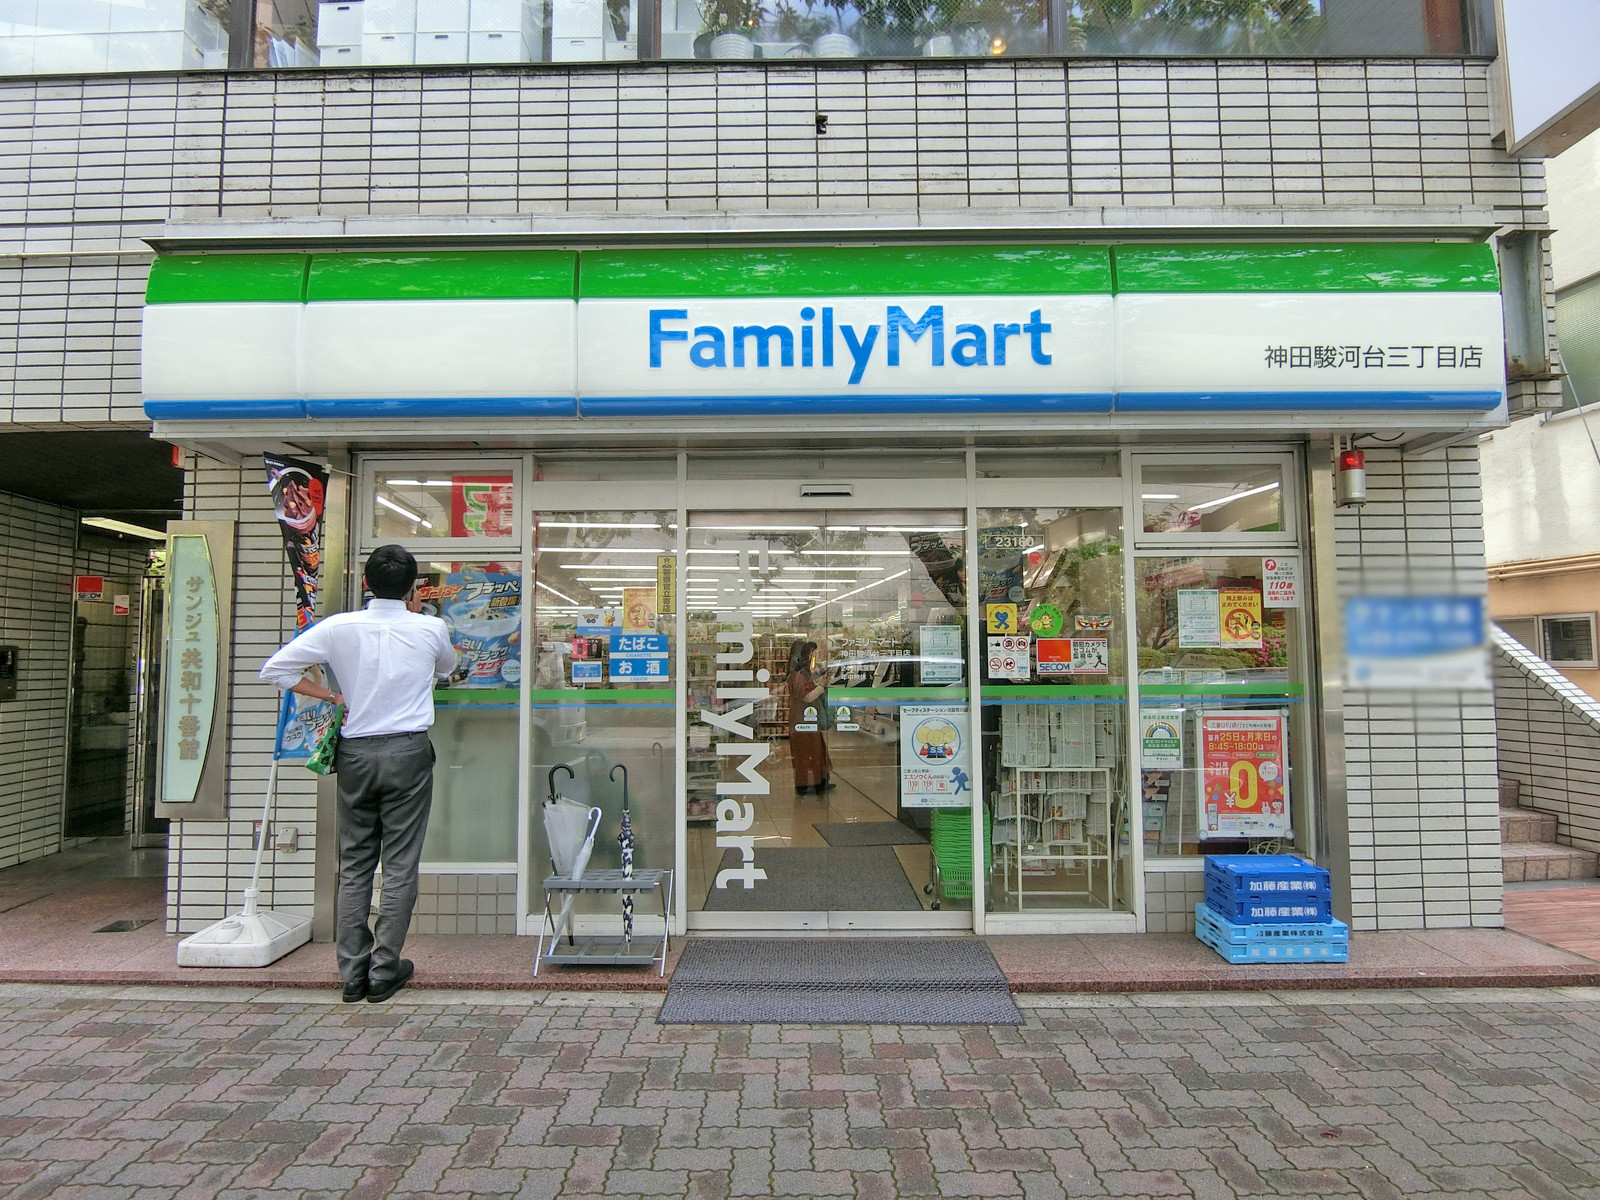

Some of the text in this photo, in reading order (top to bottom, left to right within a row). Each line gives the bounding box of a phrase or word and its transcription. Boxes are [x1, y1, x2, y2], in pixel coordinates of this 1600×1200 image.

[649, 305, 1052, 385] FamilyMart
[1264, 345, 1483, 369] 神田駿河台三丁目店
[995, 536, 1034, 548] 23160
[465, 580, 519, 602] フラッペ
[1269, 581, 1293, 590] 110番
[618, 637, 659, 650] たばこ
[840, 637, 899, 647] ファミリーマート
[177, 575, 204, 760] サンジュ共和十番館
[618, 660, 661, 675] お酒
[1039, 663, 1070, 671] SECOM
[700, 540, 770, 889] FamilyMart
[1208, 732, 1278, 741] 毎月25日と月末日の
[1249, 880, 1317, 891] 加藤産業(株)
[1250, 907, 1318, 917] 加藤産業(株)
